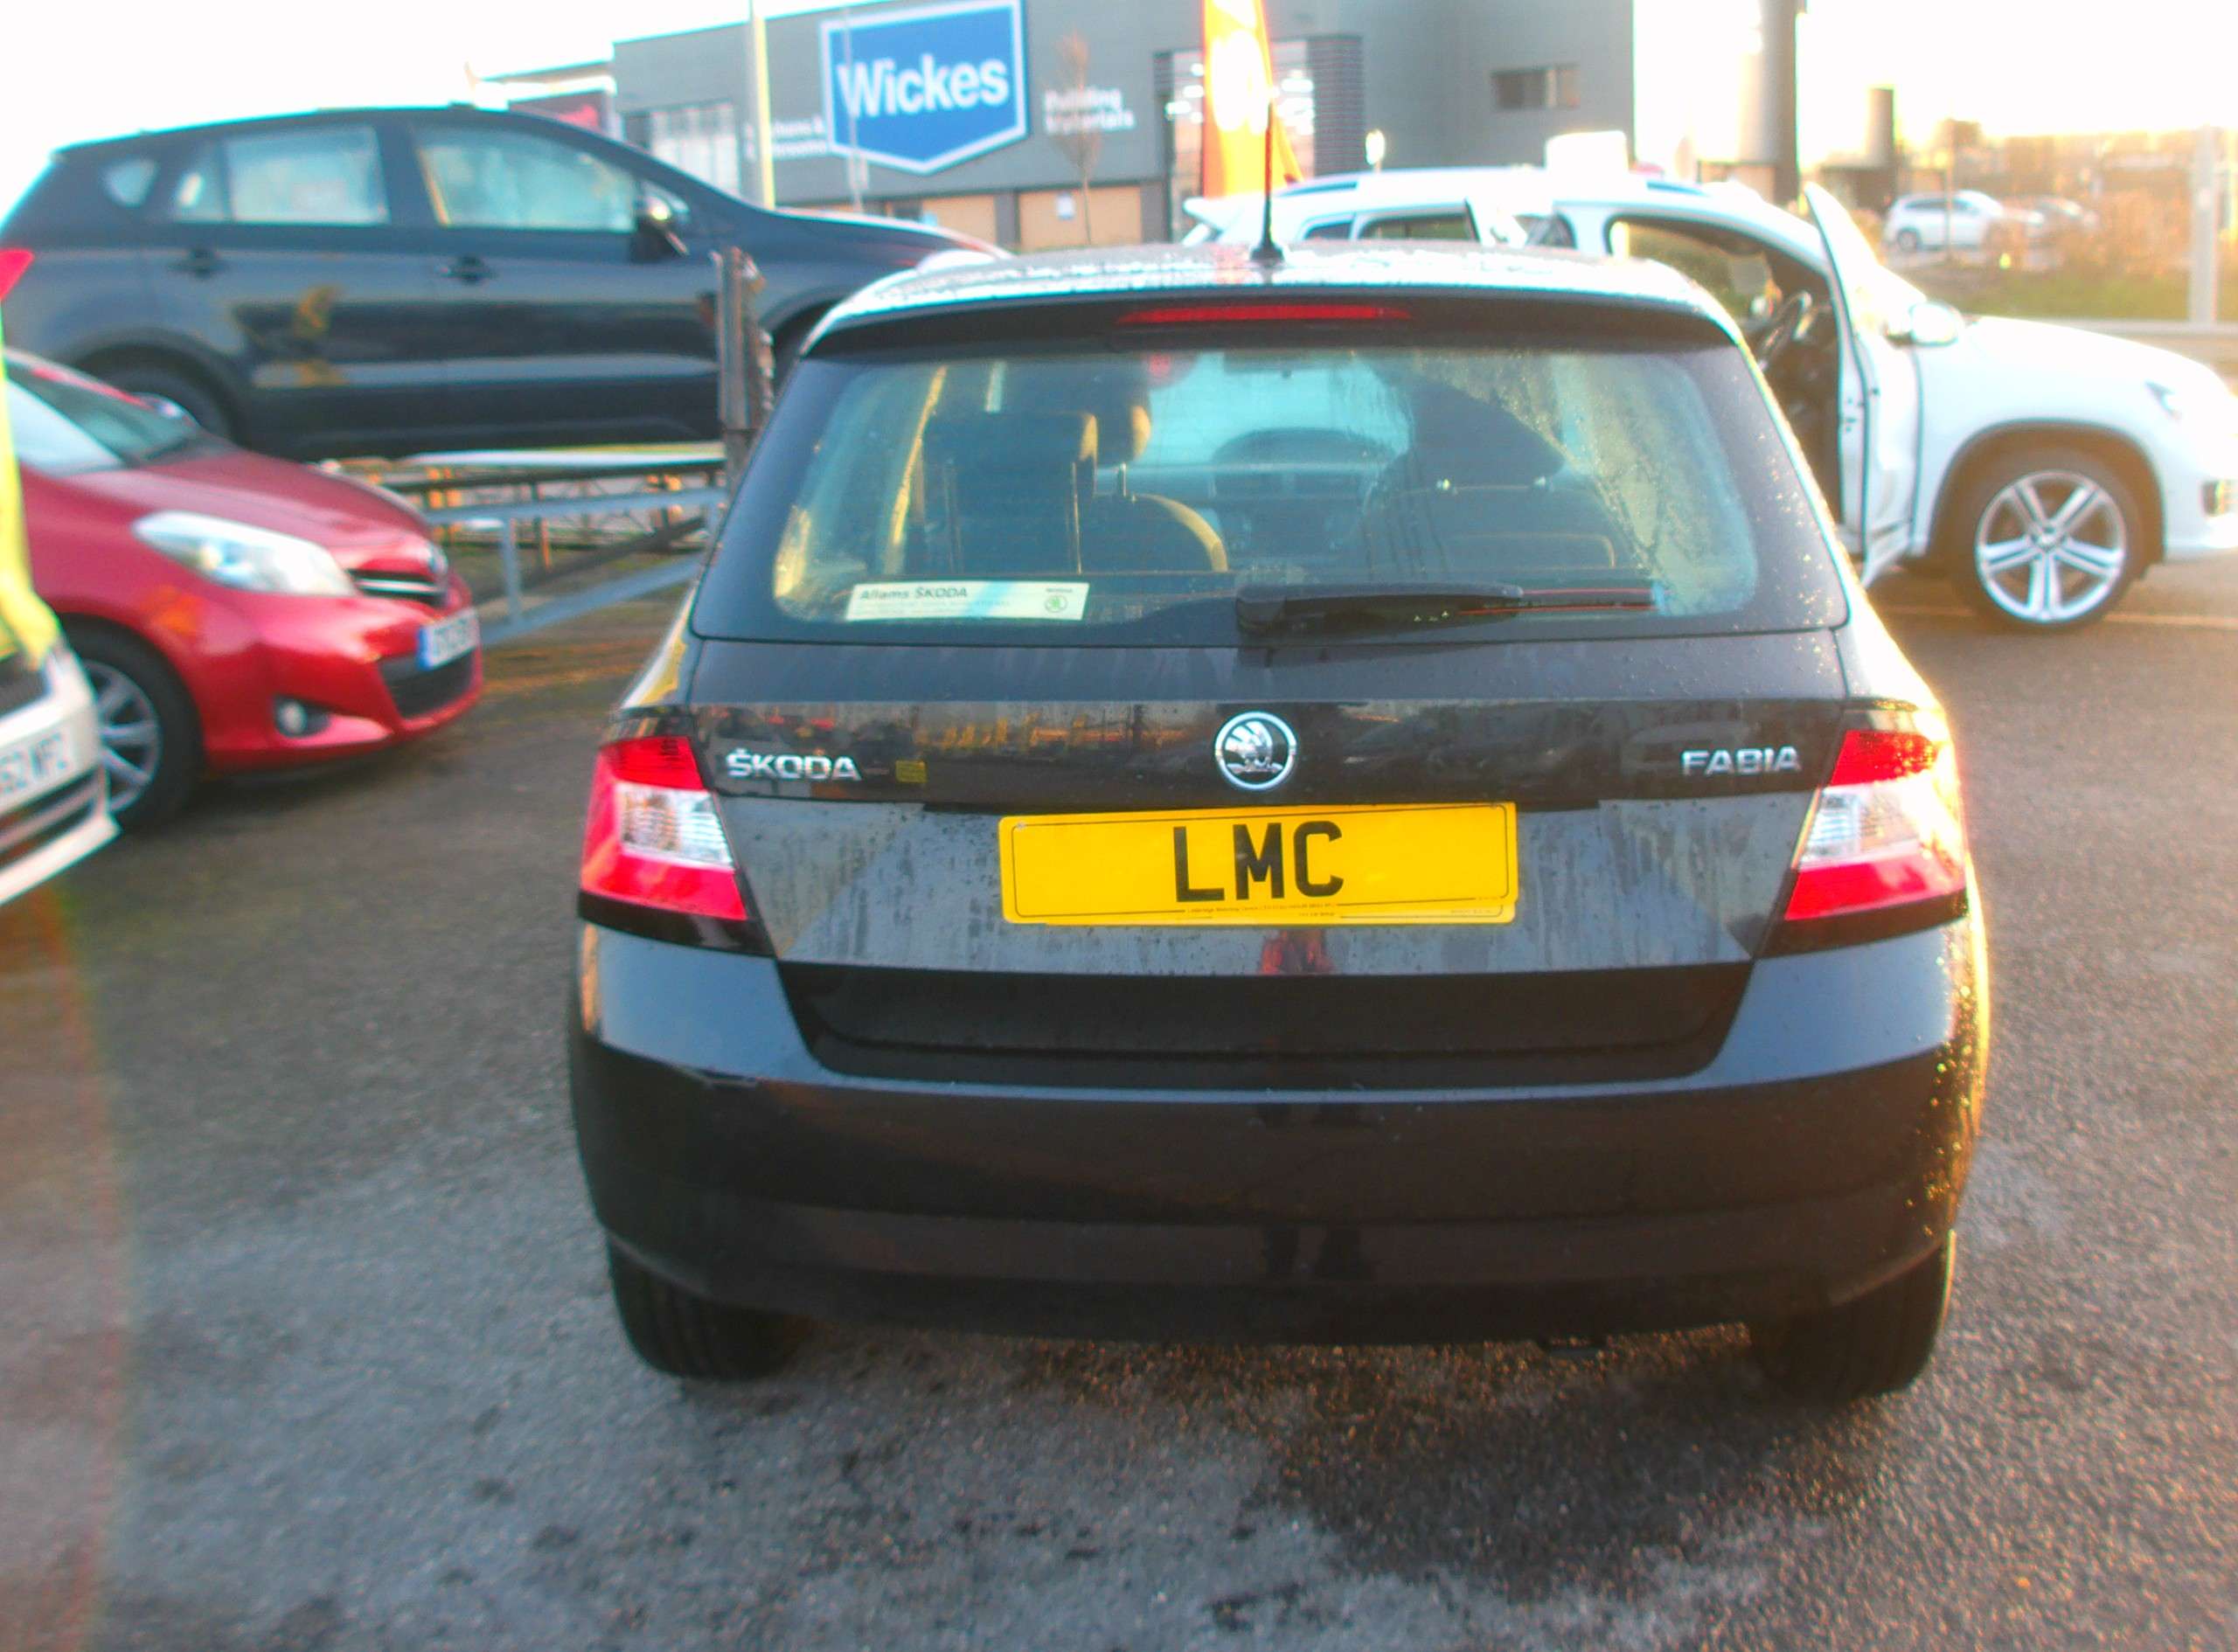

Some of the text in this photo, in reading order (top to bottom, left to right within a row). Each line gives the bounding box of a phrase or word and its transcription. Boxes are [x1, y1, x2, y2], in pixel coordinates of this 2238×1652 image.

[837, 52, 1009, 118] Wickes
[726, 747, 862, 781] ŠKODA
[1681, 746, 1803, 777] FABIA
[1173, 821, 1345, 903] LMC
